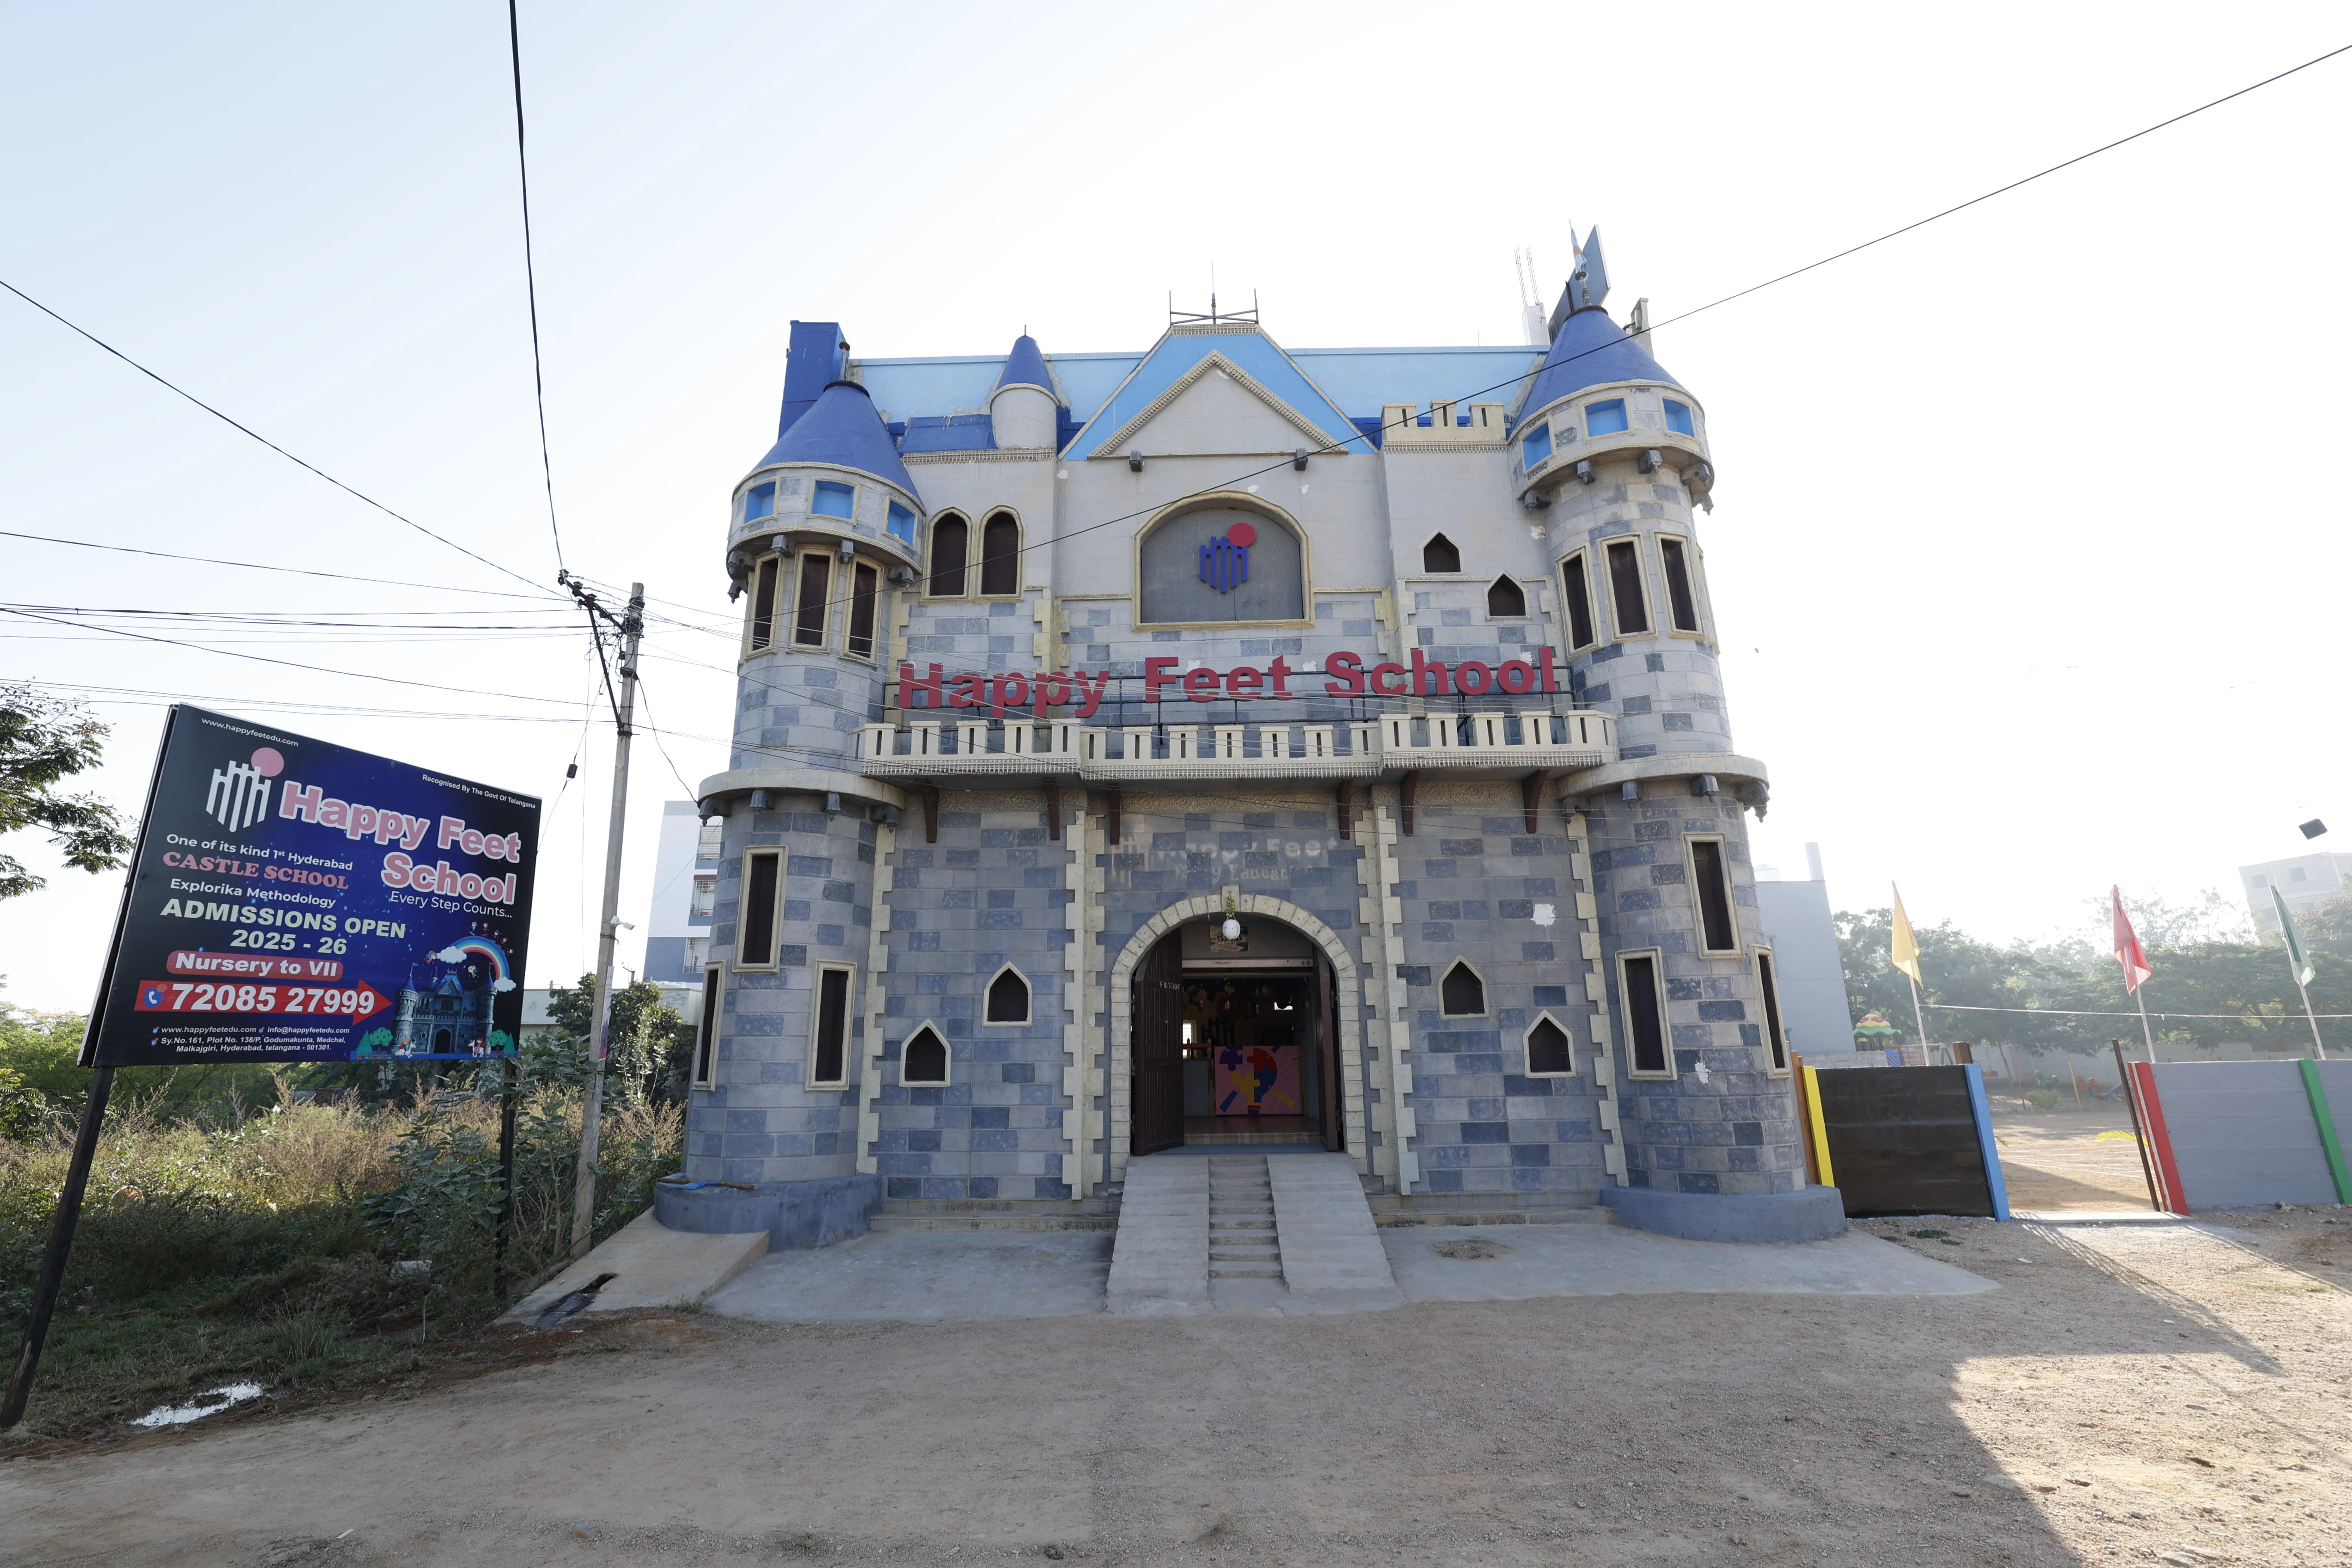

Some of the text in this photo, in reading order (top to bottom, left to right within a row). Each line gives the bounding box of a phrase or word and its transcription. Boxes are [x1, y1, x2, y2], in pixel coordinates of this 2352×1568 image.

[898, 647, 1556, 718] Happy Feet School
[202, 718, 298, 746] www.happyfeetedu.com
[422, 774, 460, 790] Recognised
[462, 785, 470, 793] By
[472, 787, 483, 795] The
[484, 791, 499, 799] Govt
[508, 797, 536, 808] Telangana
[279, 780, 521, 862] Happy Feet
[166, 834, 353, 871] One of its kind 1st Hyderabad
[163, 851, 349, 890] CASTLE SCHOOL
[381, 852, 516, 905] School
[170, 878, 336, 909] Explorika Methodology
[391, 891, 512, 918] Every Step Counts...
[160, 898, 406, 939] ADMISSIONS OPEN
[230, 929, 296, 950] 2025
[318, 937, 347, 955] 26
[175, 952, 337, 977] Nursery to VII
[172, 983, 374, 1014] 72085 27999
[161, 1037, 204, 1045] Sy.No.161,
[176, 1045, 218, 1053] Malkajgiri,
